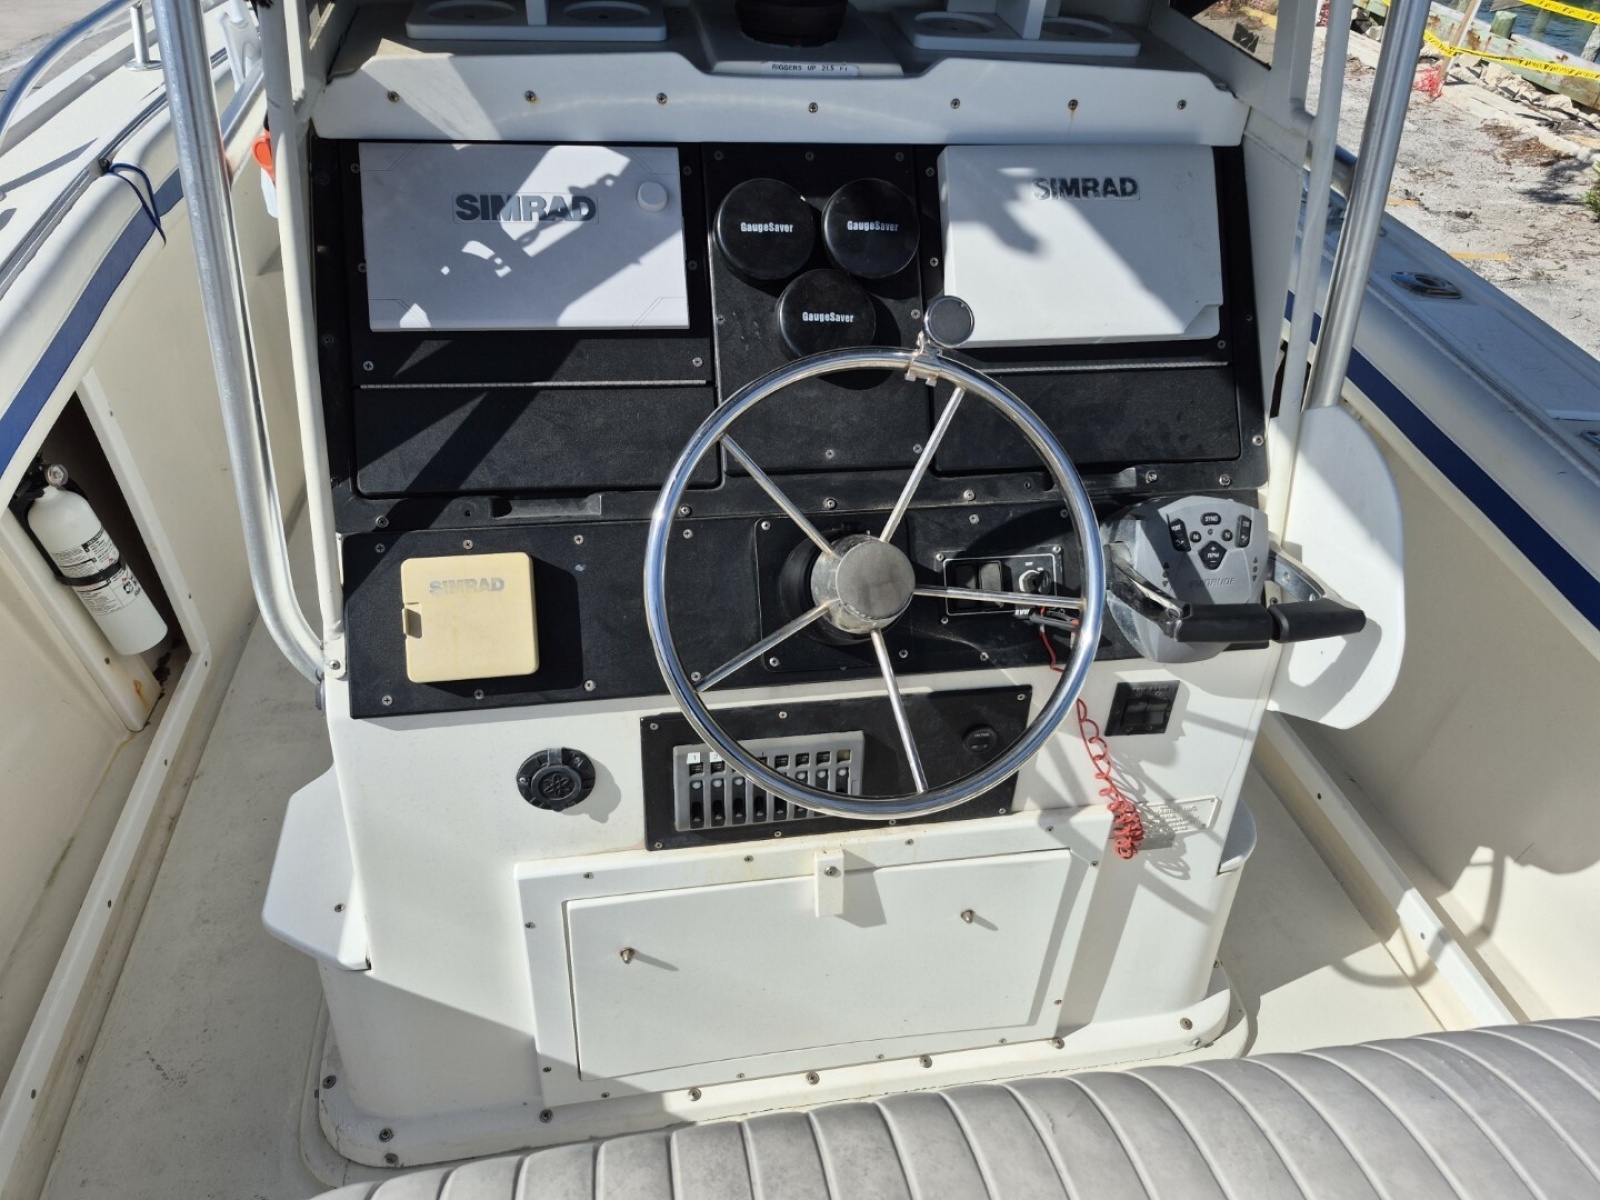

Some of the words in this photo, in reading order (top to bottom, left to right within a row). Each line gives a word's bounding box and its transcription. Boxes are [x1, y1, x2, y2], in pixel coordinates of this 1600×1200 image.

[1033, 177, 1138, 200] SIMRAD
[455, 194, 597, 221] SIMRAD
[740, 222, 794, 233] GaugeSaver
[847, 220, 899, 232] GaugeSaver
[802, 311, 854, 323] GaugeSaver
[429, 577, 505, 594] SIMRAD
